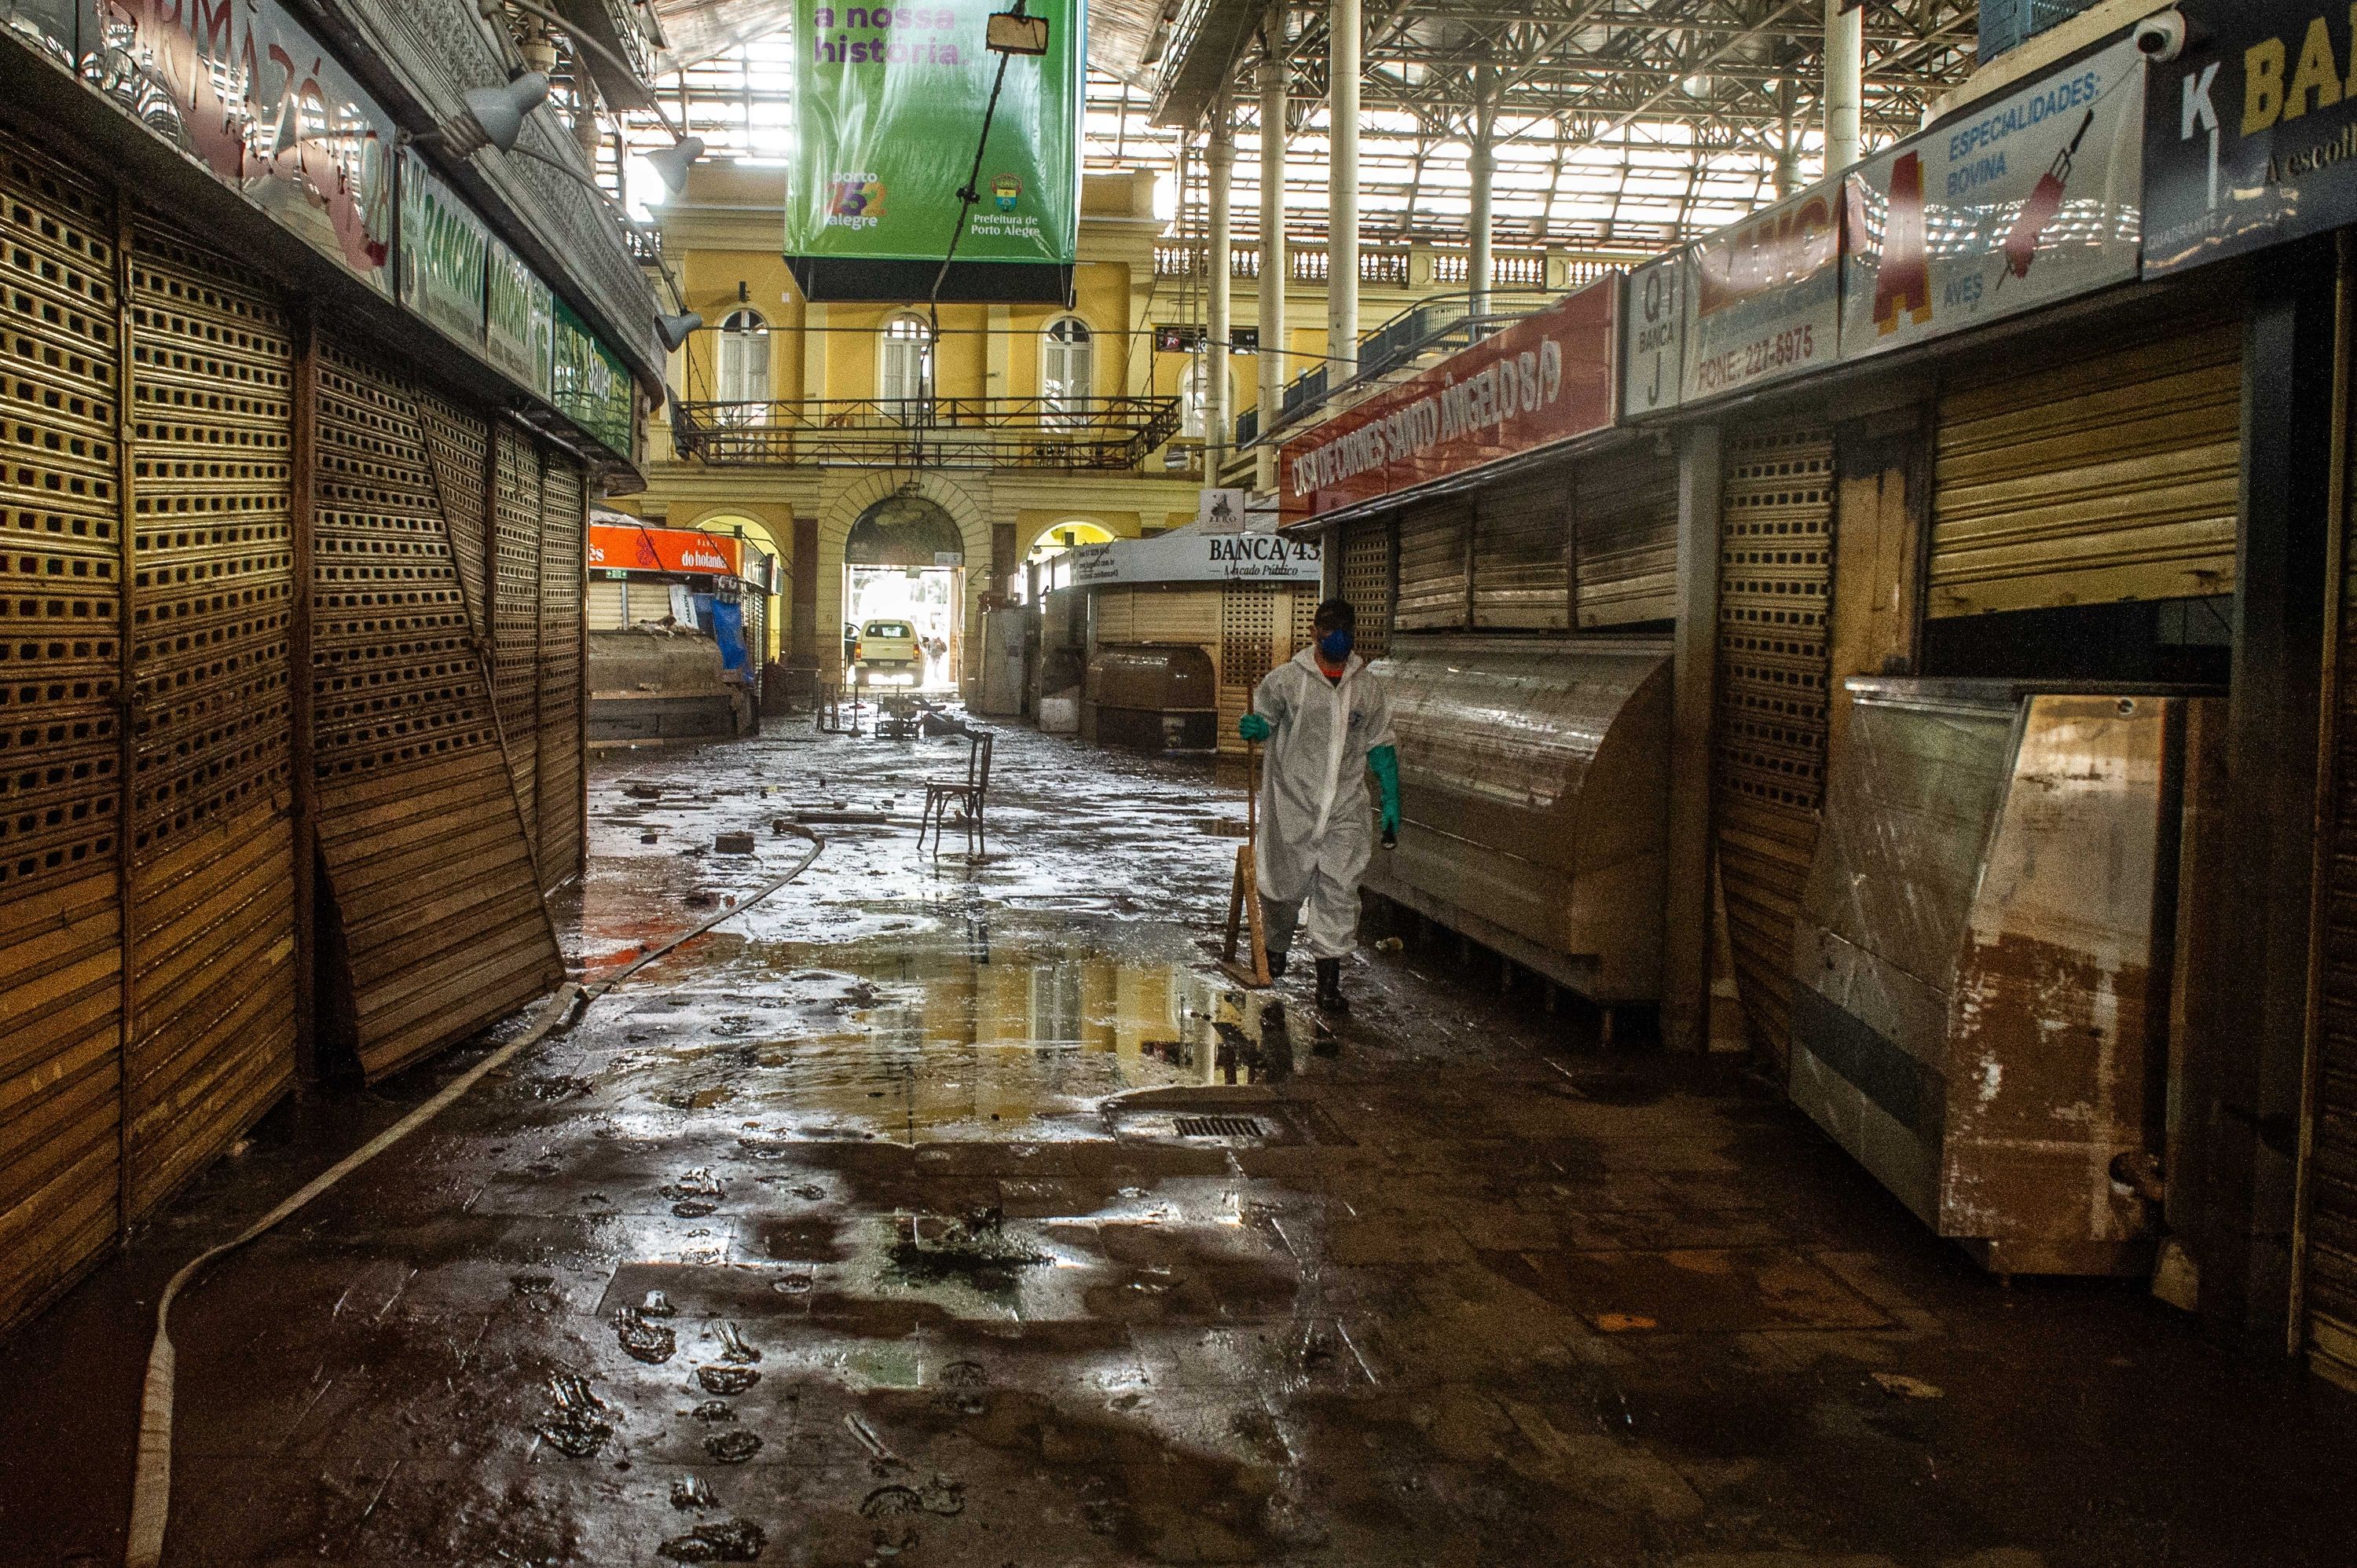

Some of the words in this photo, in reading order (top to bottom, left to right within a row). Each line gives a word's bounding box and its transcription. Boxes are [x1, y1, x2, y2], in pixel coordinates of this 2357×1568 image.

[814, 7, 834, 28] a
[847, 6, 955, 30] nossa
[2240, 2, 2357, 138] BA
[1948, 71, 2101, 163] ESPECIALIDADES:
[2180, 61, 2221, 141] K
[832, 172, 878, 185] porto
[1947, 152, 2008, 197] BOVINA
[827, 213, 878, 230] alegre
[971, 224, 1002, 236] Porto
[1004, 224, 1040, 238] Alegre
[973, 214, 1022, 225] Prefeitura
[1025, 215, 1039, 225] de
[1644, 269, 1662, 323] Q
[1639, 320, 1673, 354] BANCA
[1647, 351, 1661, 406] J
[1386, 396, 1439, 463] SANTO
[681, 550, 695, 567] do
[1210, 538, 1285, 561] BANCA
